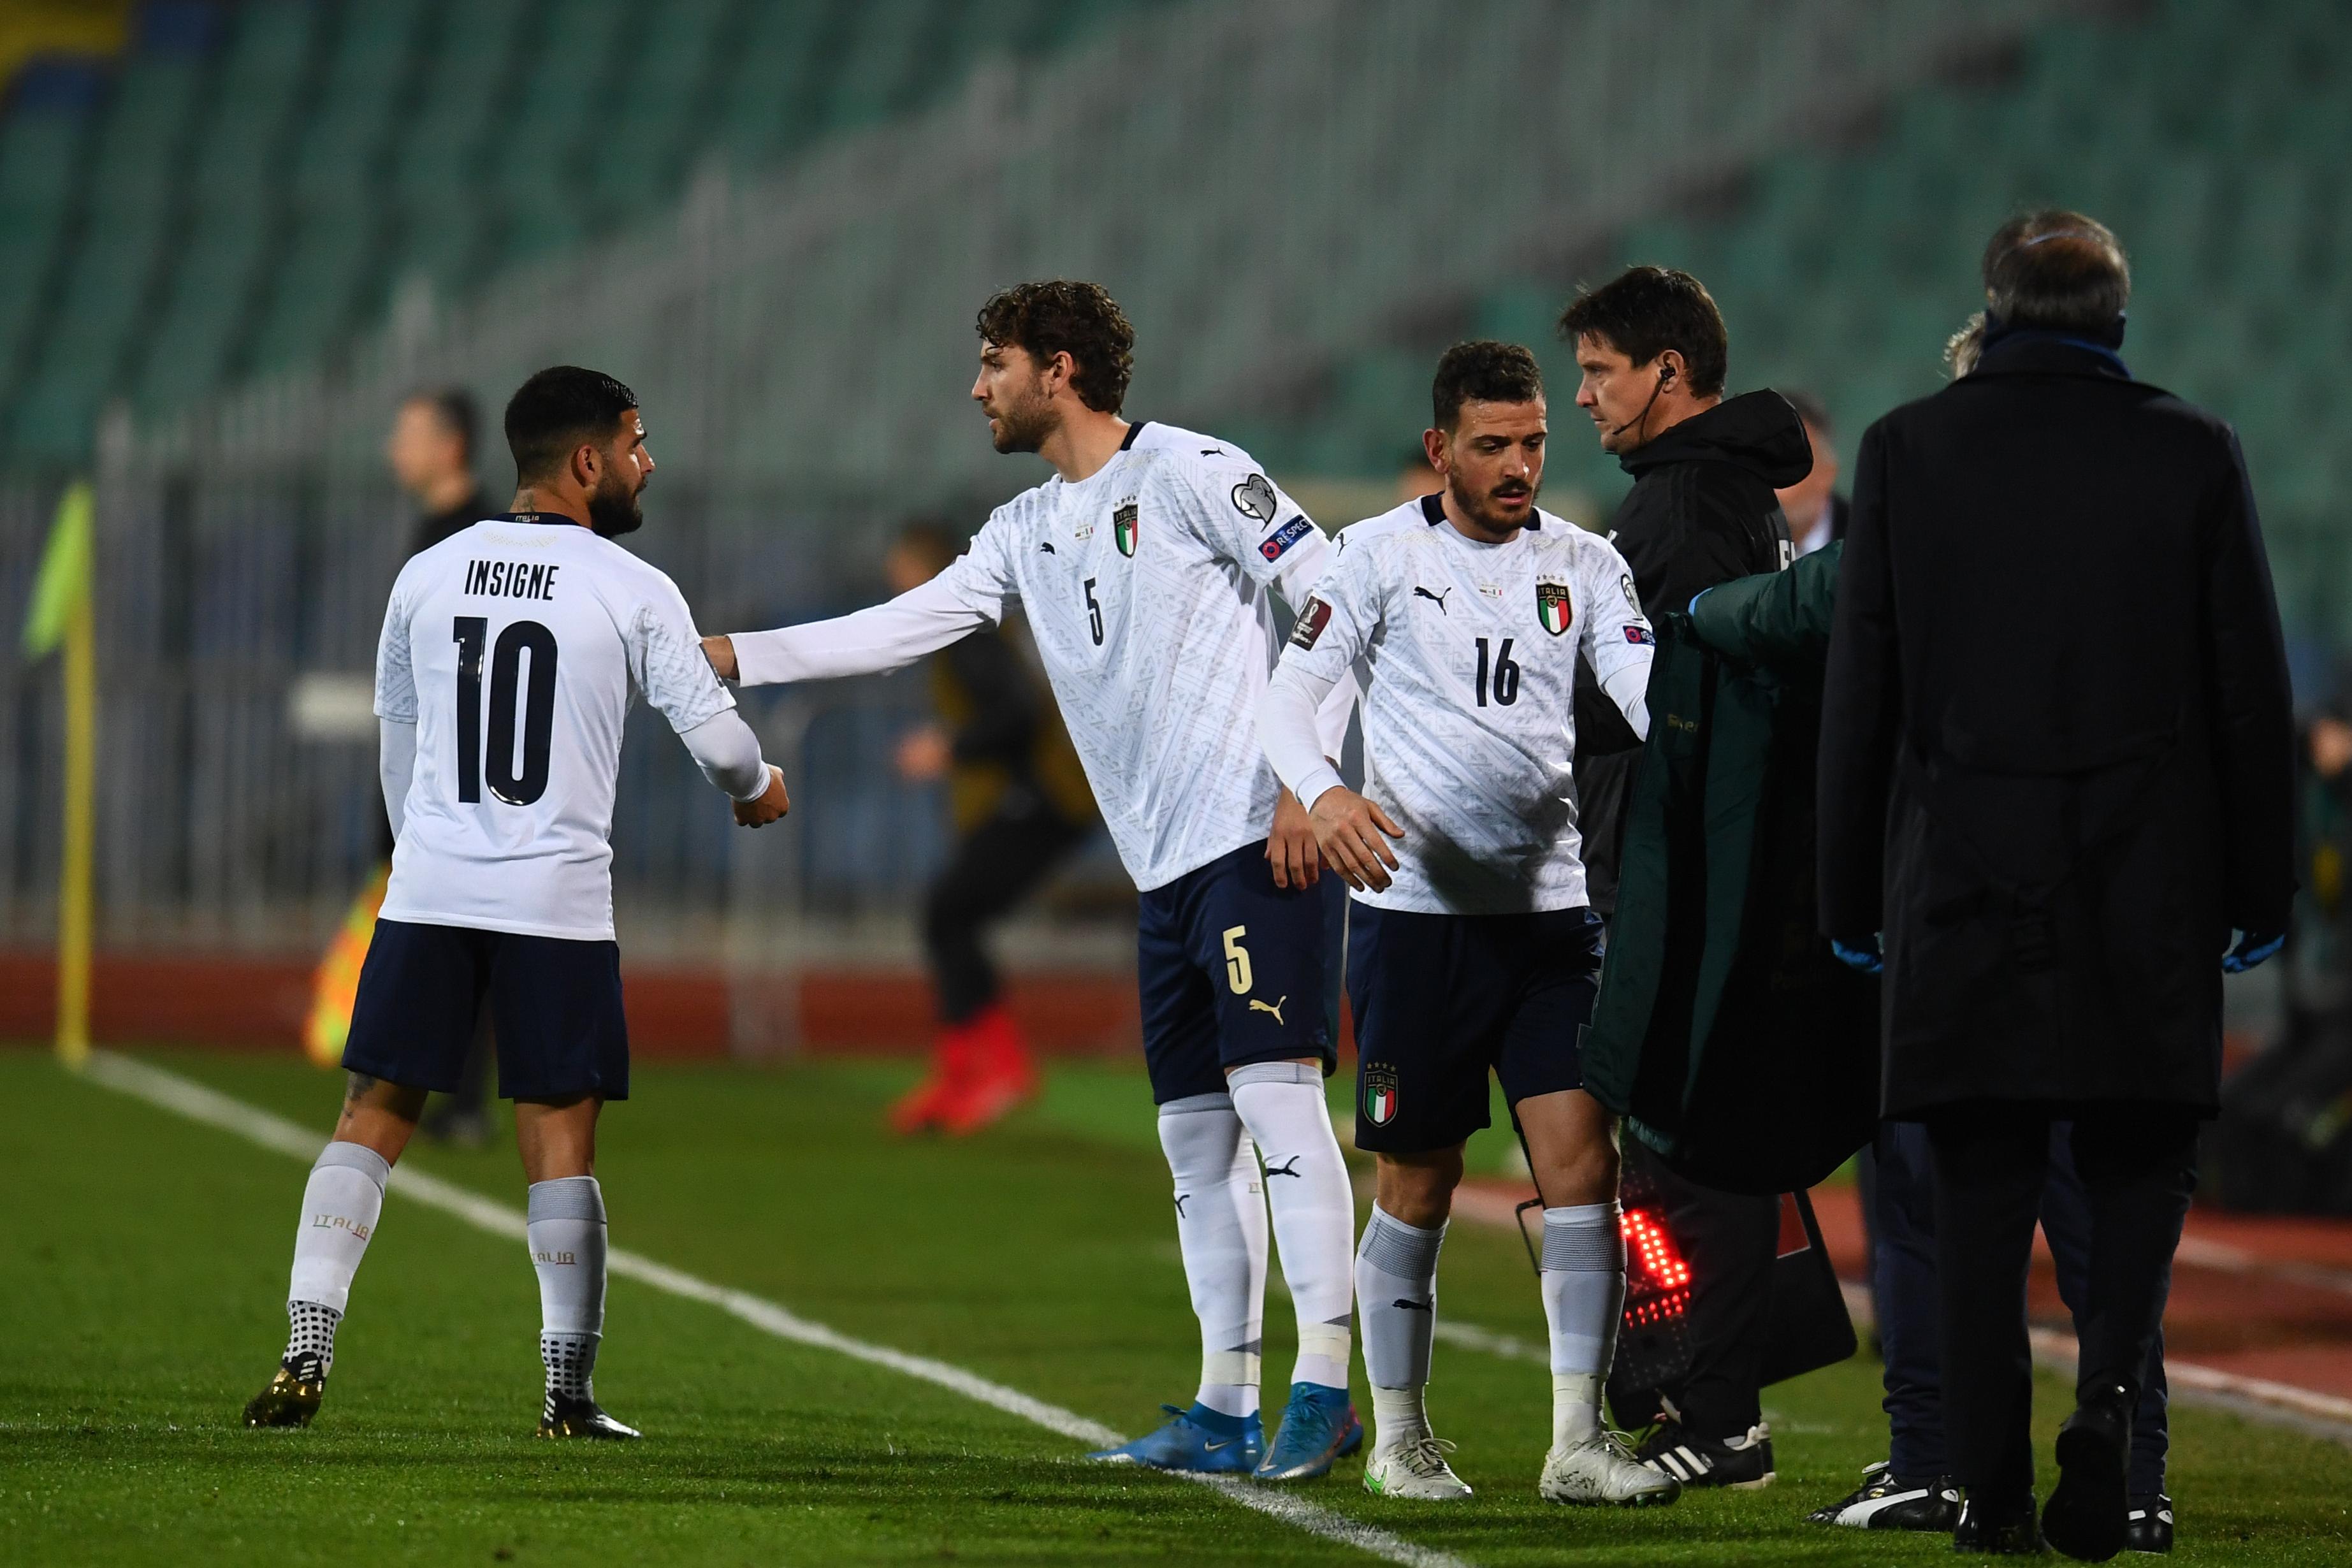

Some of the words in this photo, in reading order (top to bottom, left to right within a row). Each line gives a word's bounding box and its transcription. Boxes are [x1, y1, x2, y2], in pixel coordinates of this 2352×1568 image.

[465, 560, 559, 600] INSIGNE
[1538, 587, 1565, 595] ITALIA
[1084, 577, 1103, 646] 5
[1476, 637, 1520, 707] 16
[453, 616, 558, 806] 10
[1223, 925, 1252, 994] 5
[1368, 1075, 1395, 1085] ITALIA
[314, 1215, 369, 1238] ITALIA
[532, 1252, 574, 1262] TALIA
